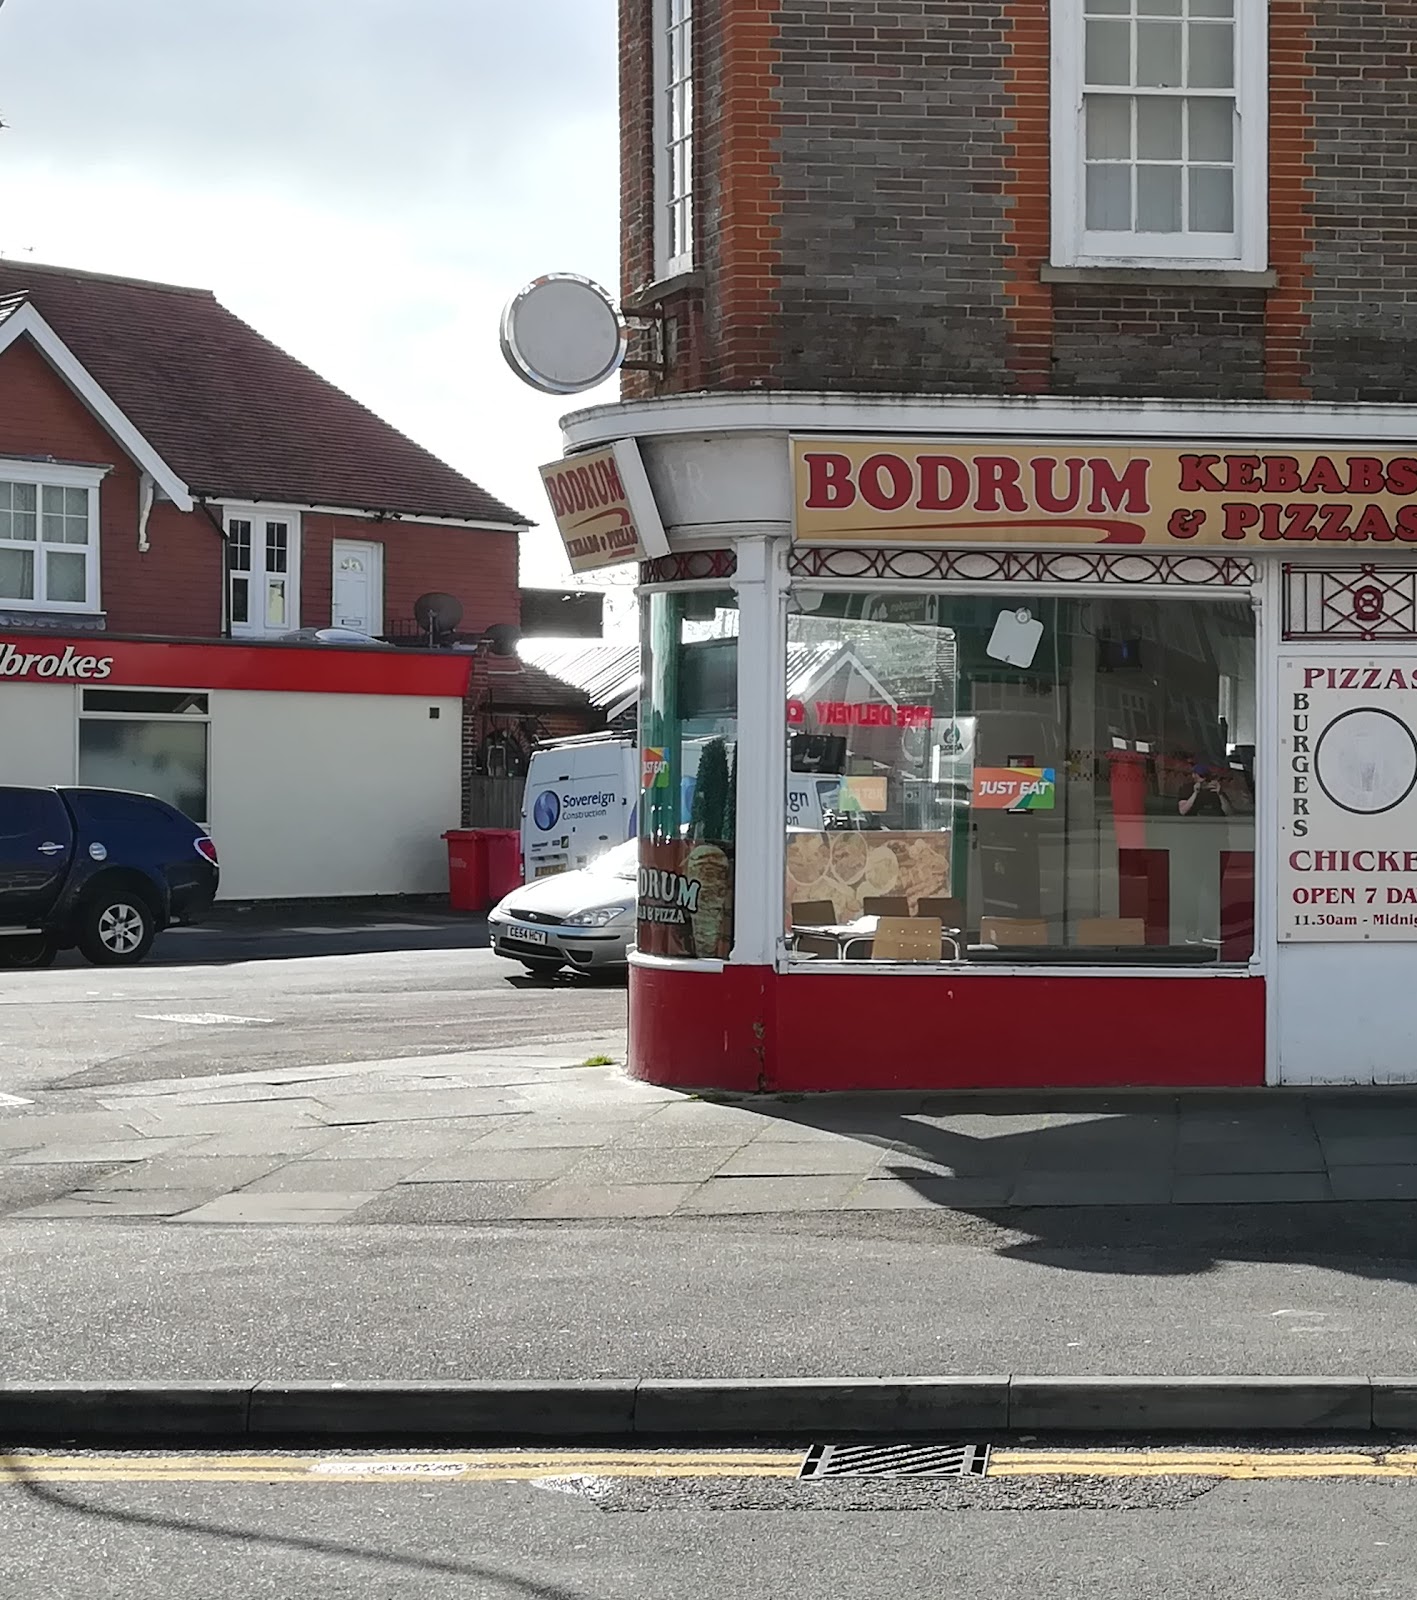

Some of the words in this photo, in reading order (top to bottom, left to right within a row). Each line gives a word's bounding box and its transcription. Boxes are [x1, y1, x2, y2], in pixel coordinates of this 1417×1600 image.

[545, 457, 626, 518] BODRUM
[803, 453, 1151, 513] BODRUM
[1167, 508, 1206, 539] &
[0, 643, 114, 679] brokes
[1291, 692, 1311, 838] BURGERS
[562, 790, 616, 809] Sovereign
[978, 781, 1017, 796] JUST
[1018, 780, 1051, 796] EAT
[562, 809, 607, 820] Construction
[638, 867, 701, 913] DRUM
[1292, 887, 1356, 905] OPEN
[1364, 887, 1378, 905] 7
[654, 907, 686, 924] PIZZA
[1294, 914, 1358, 926] 11.30am
